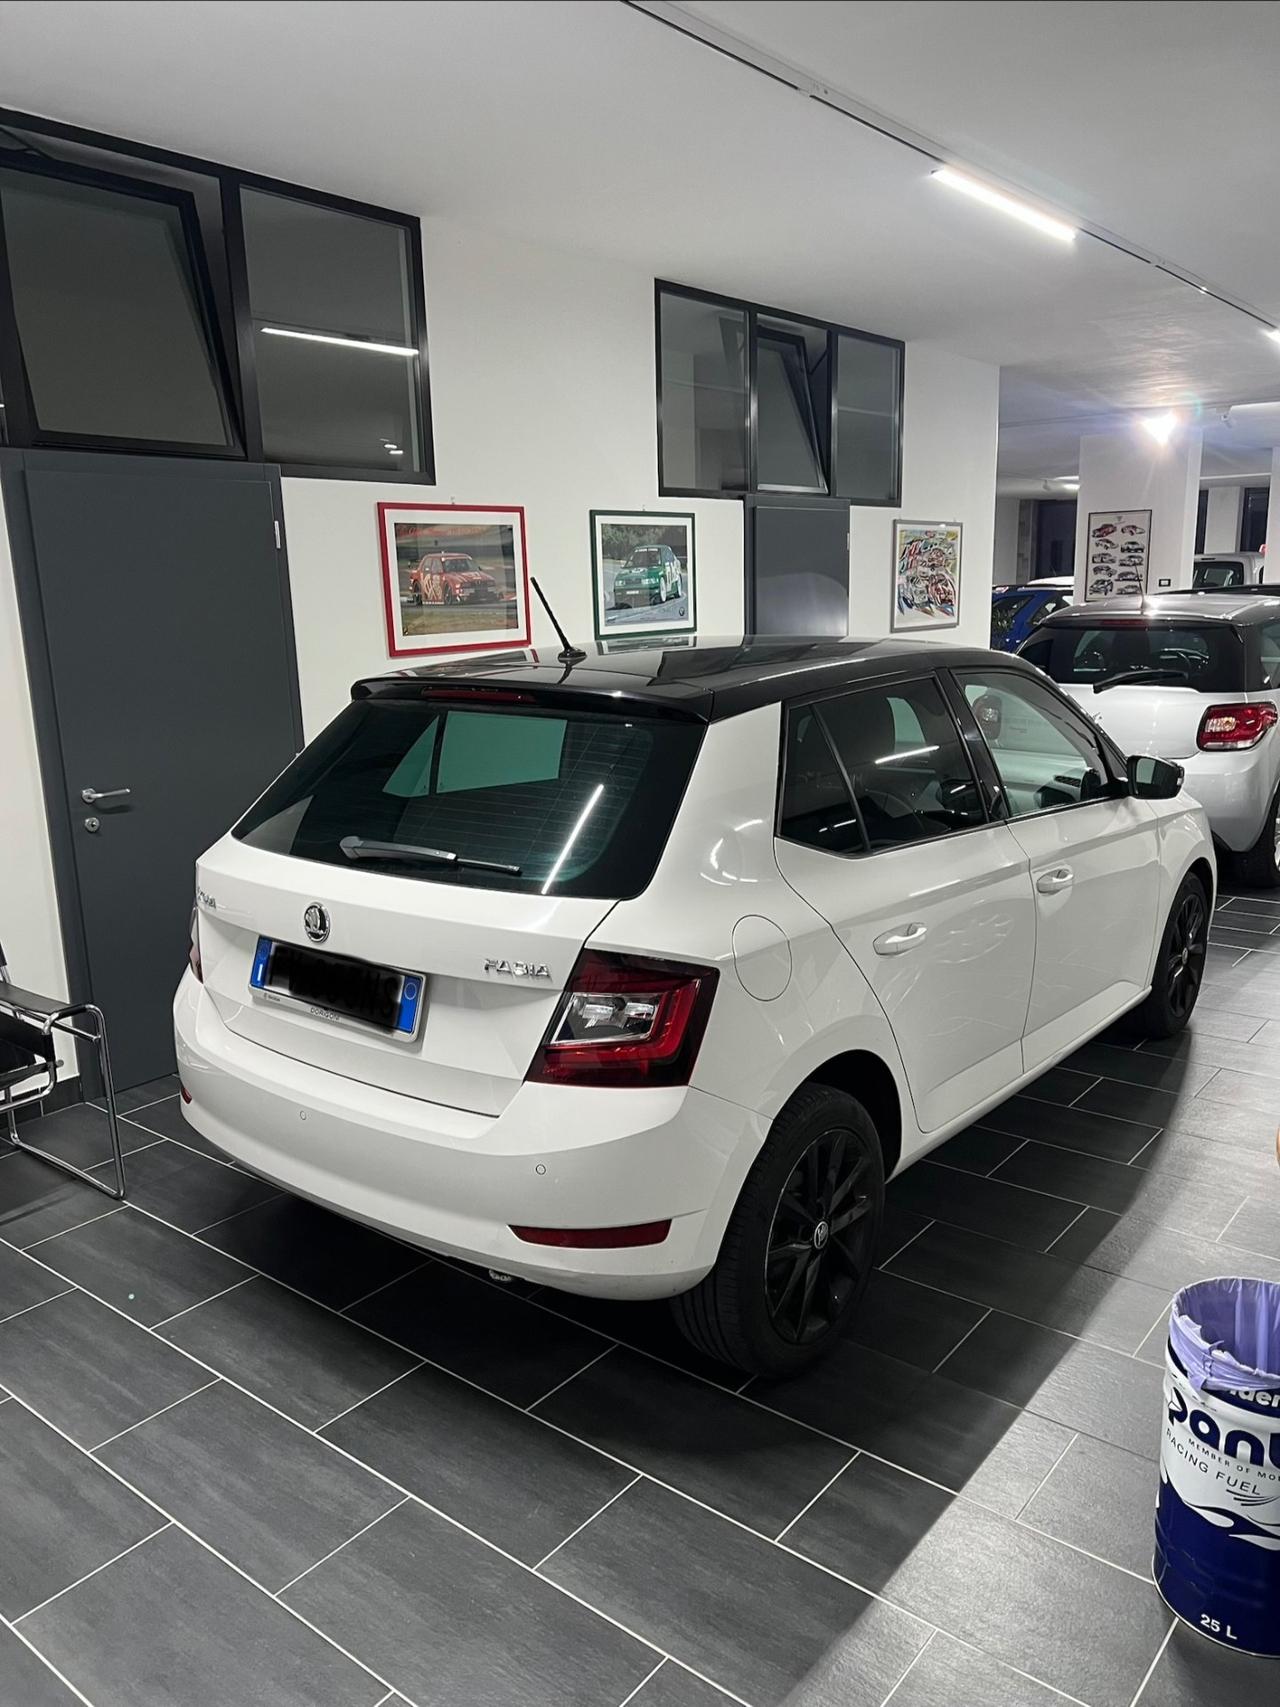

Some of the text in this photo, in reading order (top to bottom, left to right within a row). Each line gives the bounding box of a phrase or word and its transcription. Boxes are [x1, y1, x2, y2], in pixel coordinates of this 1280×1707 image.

[484, 958, 552, 980] FABIA
[1166, 1427, 1260, 1496] RACING FUEL
[1188, 1438, 1280, 1482] MEMBER OF MO
[1200, 1613, 1237, 1640] 25 L
